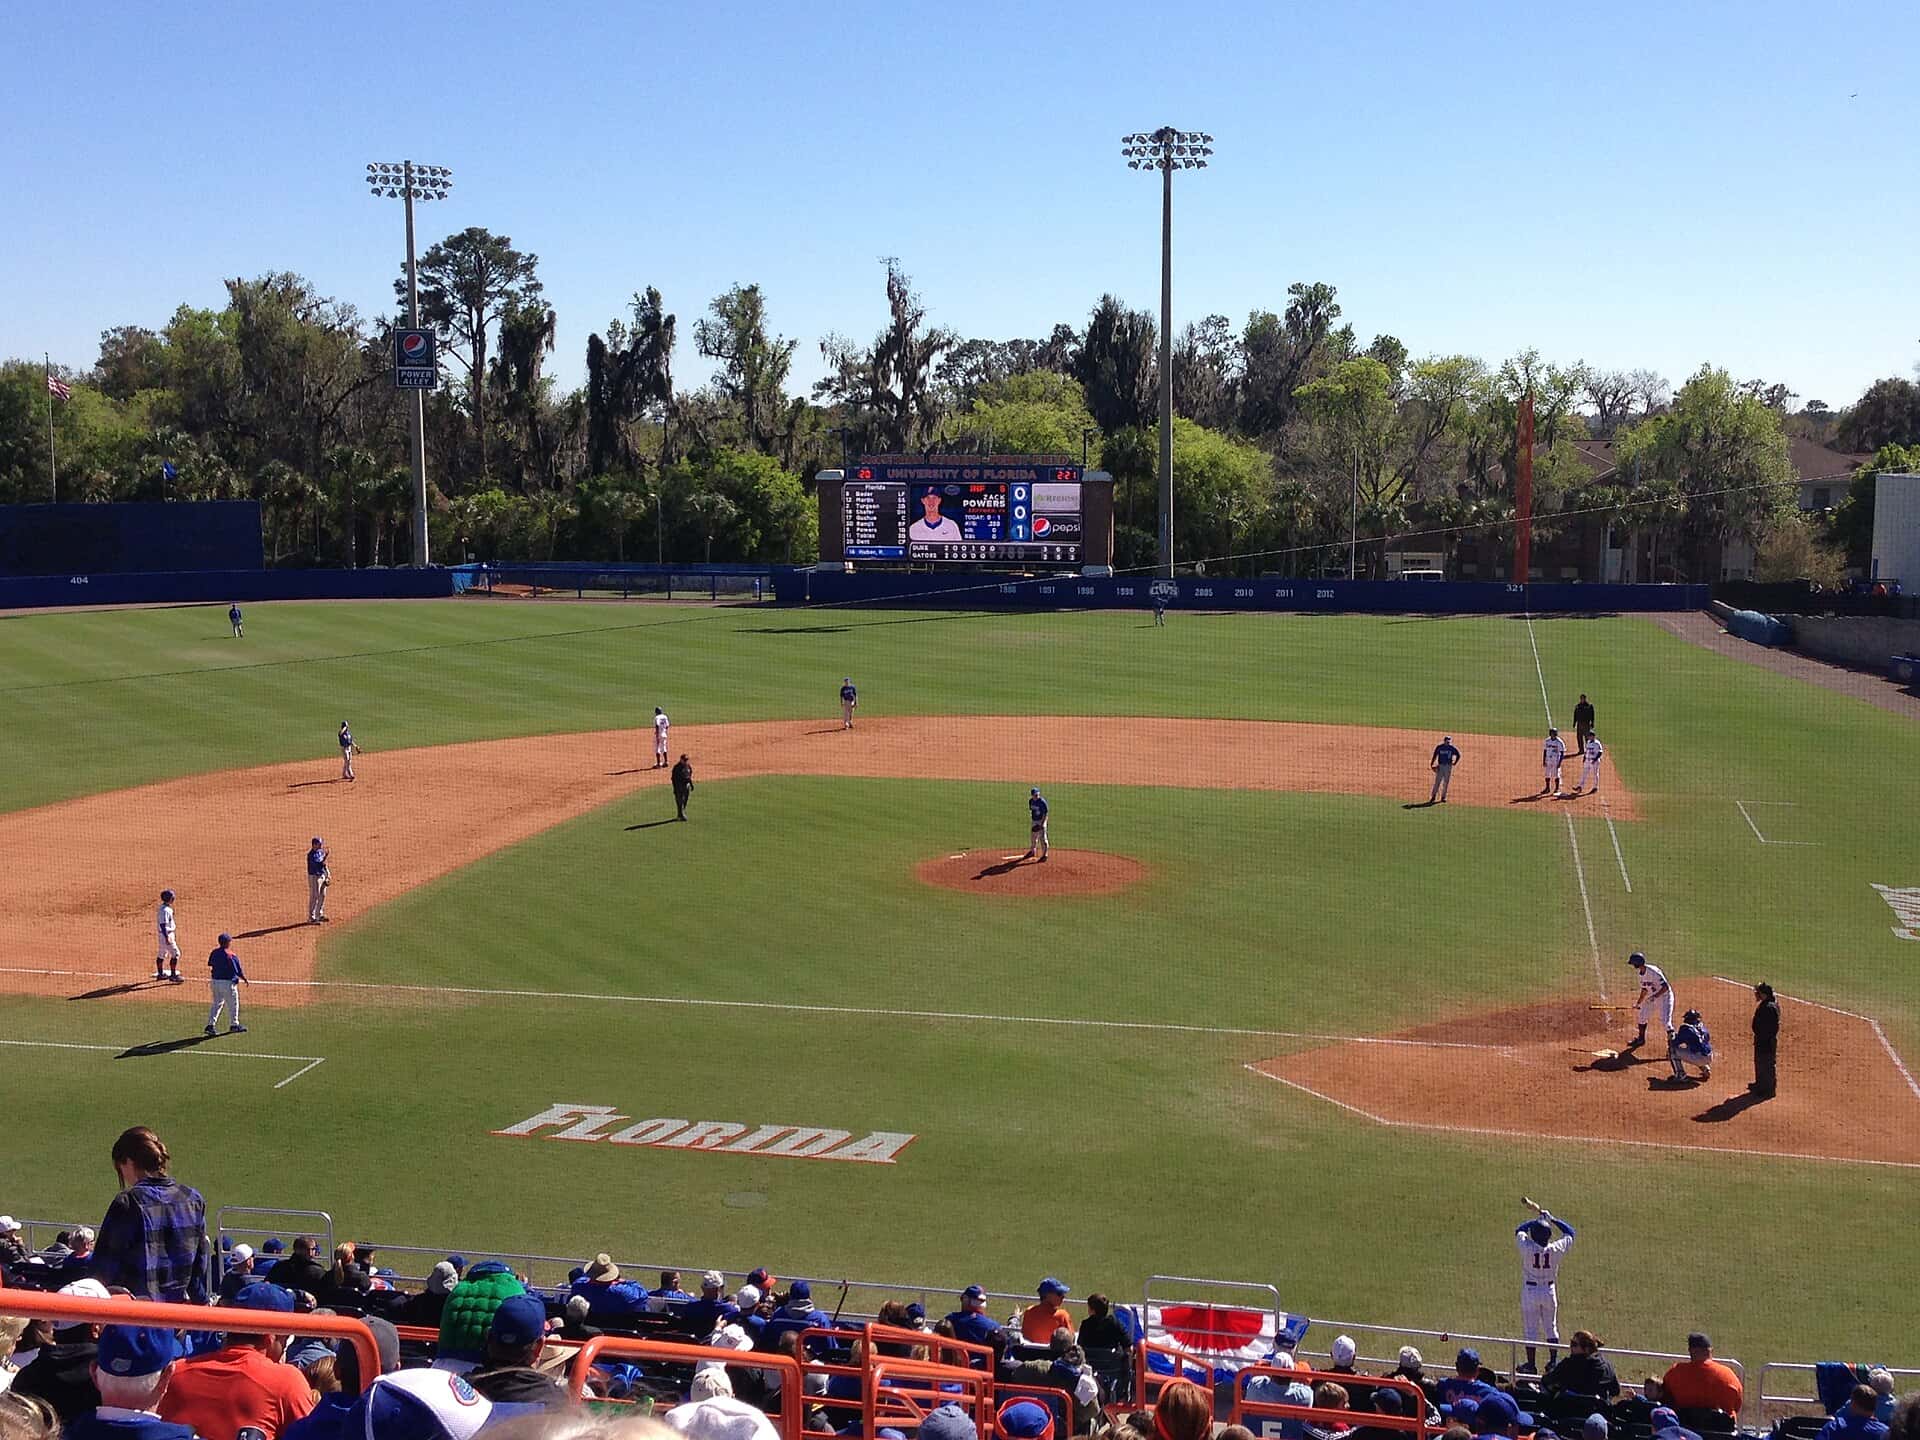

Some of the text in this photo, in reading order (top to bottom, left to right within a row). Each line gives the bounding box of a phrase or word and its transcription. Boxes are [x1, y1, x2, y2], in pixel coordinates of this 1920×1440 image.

[887, 469, 1037, 480] UNIVERSITY OF FLORIDA
[1015, 487, 1026, 501] 0
[1015, 506, 1026, 520] 0
[1016, 525, 1023, 539] 1
[1053, 523, 1081, 534] pepsi
[70, 576, 89, 584] 404
[1234, 588, 1254, 597] 2010
[1275, 588, 1294, 598] 2011
[1316, 590, 1335, 599] 2012
[1533, 1253, 1550, 1269] 11
